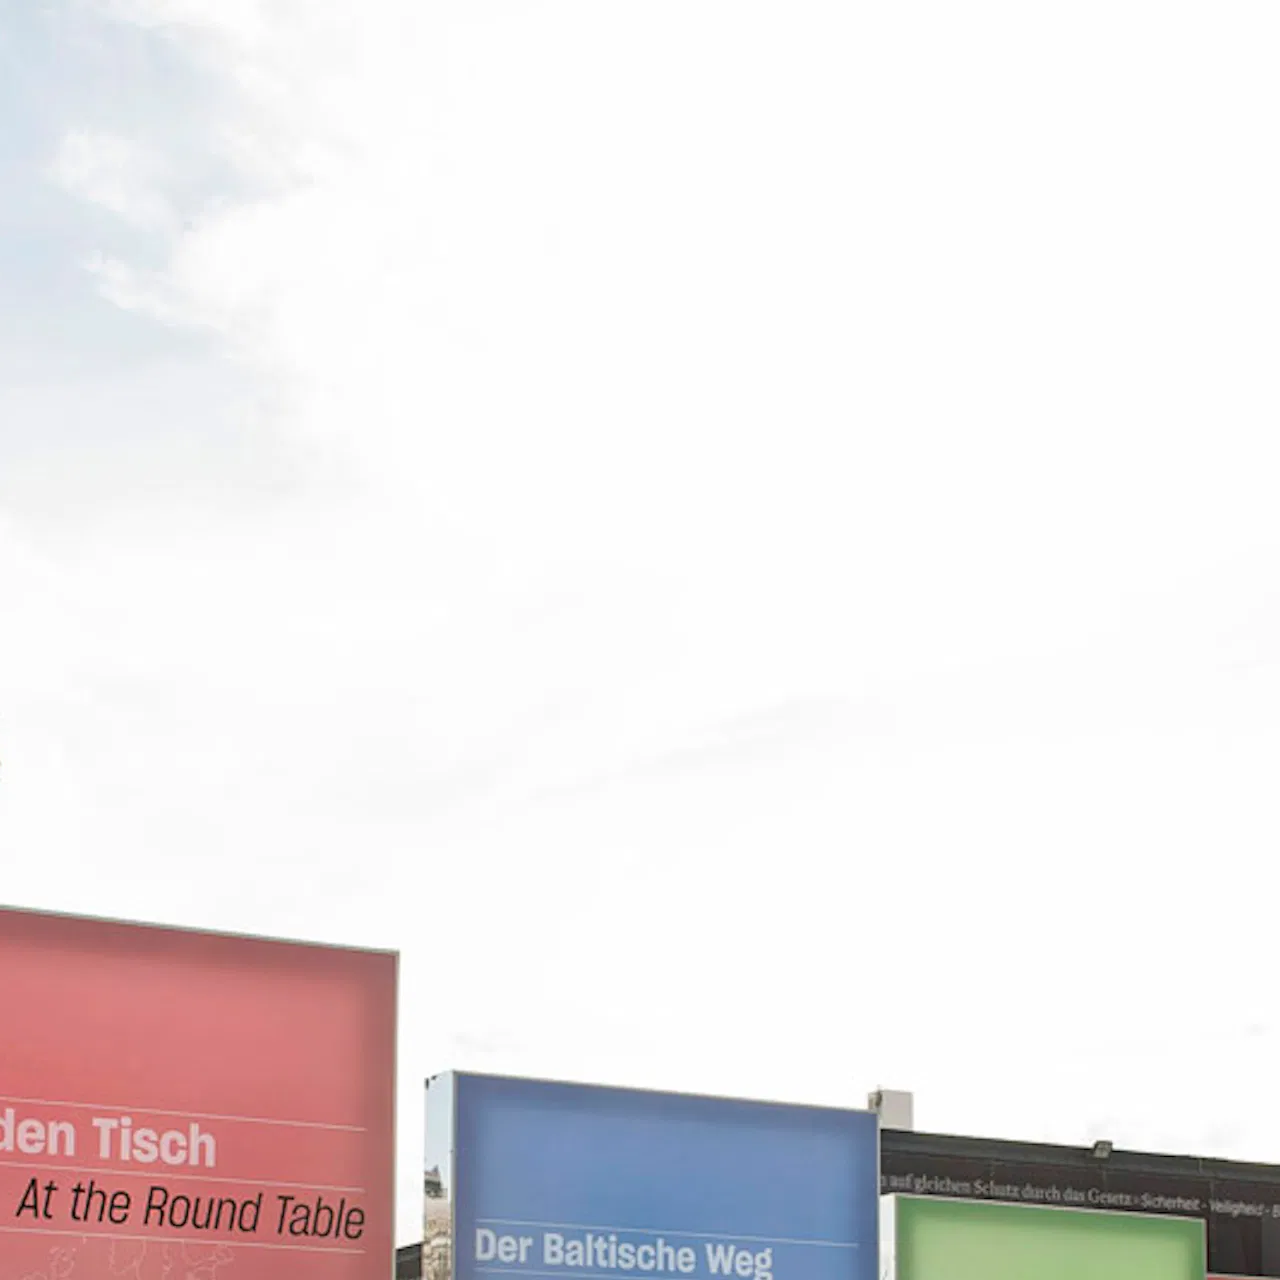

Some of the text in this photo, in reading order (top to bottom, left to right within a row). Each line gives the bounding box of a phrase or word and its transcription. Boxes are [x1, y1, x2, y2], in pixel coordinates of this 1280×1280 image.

[93, 1117, 215, 1168] Tisch
[16, 1178, 366, 1240] At the Round Table
[888, 1174, 1131, 1205] auf gleichen Schutz durch das Gesetz
[475, 1228, 532, 1264] Der
[543, 1233, 696, 1274] Baltische
